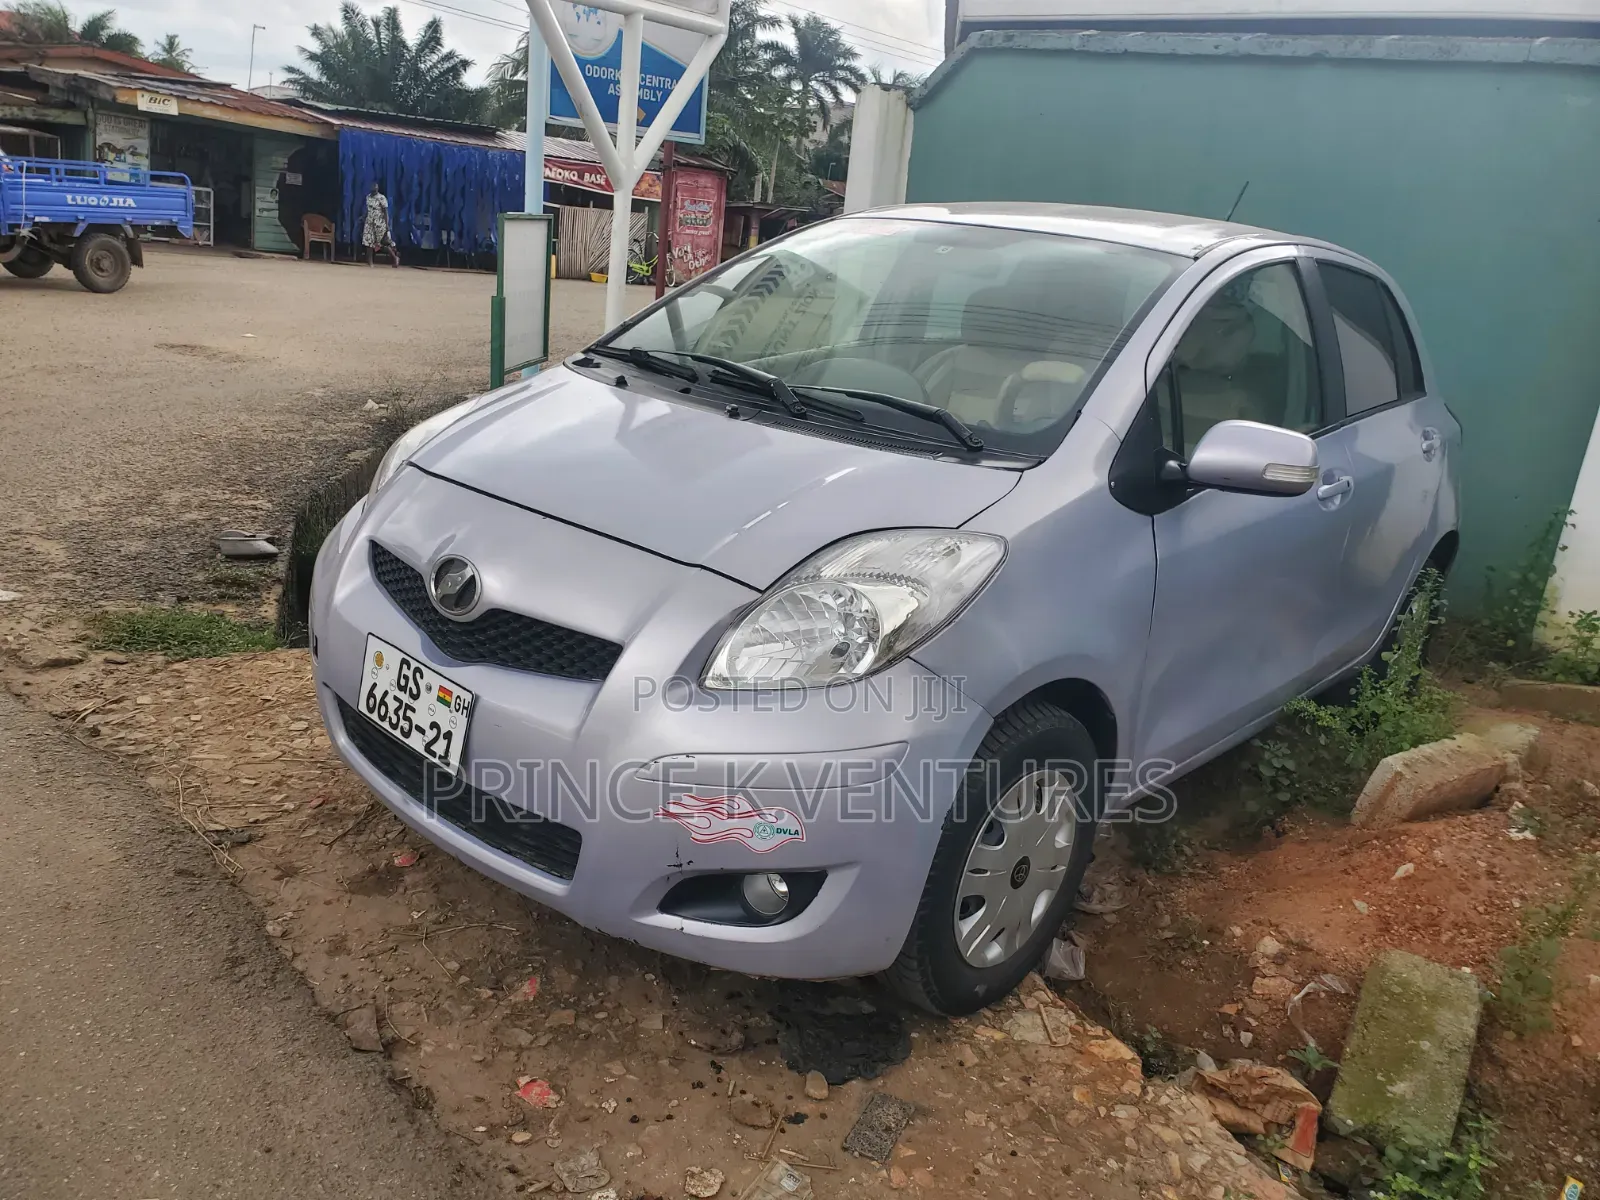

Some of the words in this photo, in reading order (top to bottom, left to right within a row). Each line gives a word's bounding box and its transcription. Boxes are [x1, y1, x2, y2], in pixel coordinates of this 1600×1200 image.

[585, 64, 623, 81] ODORK
[640, 74, 680, 90] CENTRA
[149, 96, 170, 106] BIC
[584, 172, 607, 185] BASE
[397, 657, 424, 701] GS
[454, 695, 470, 719] GH
[366, 682, 453, 767] 6635-21
[776, 827, 799, 836] DVLA
